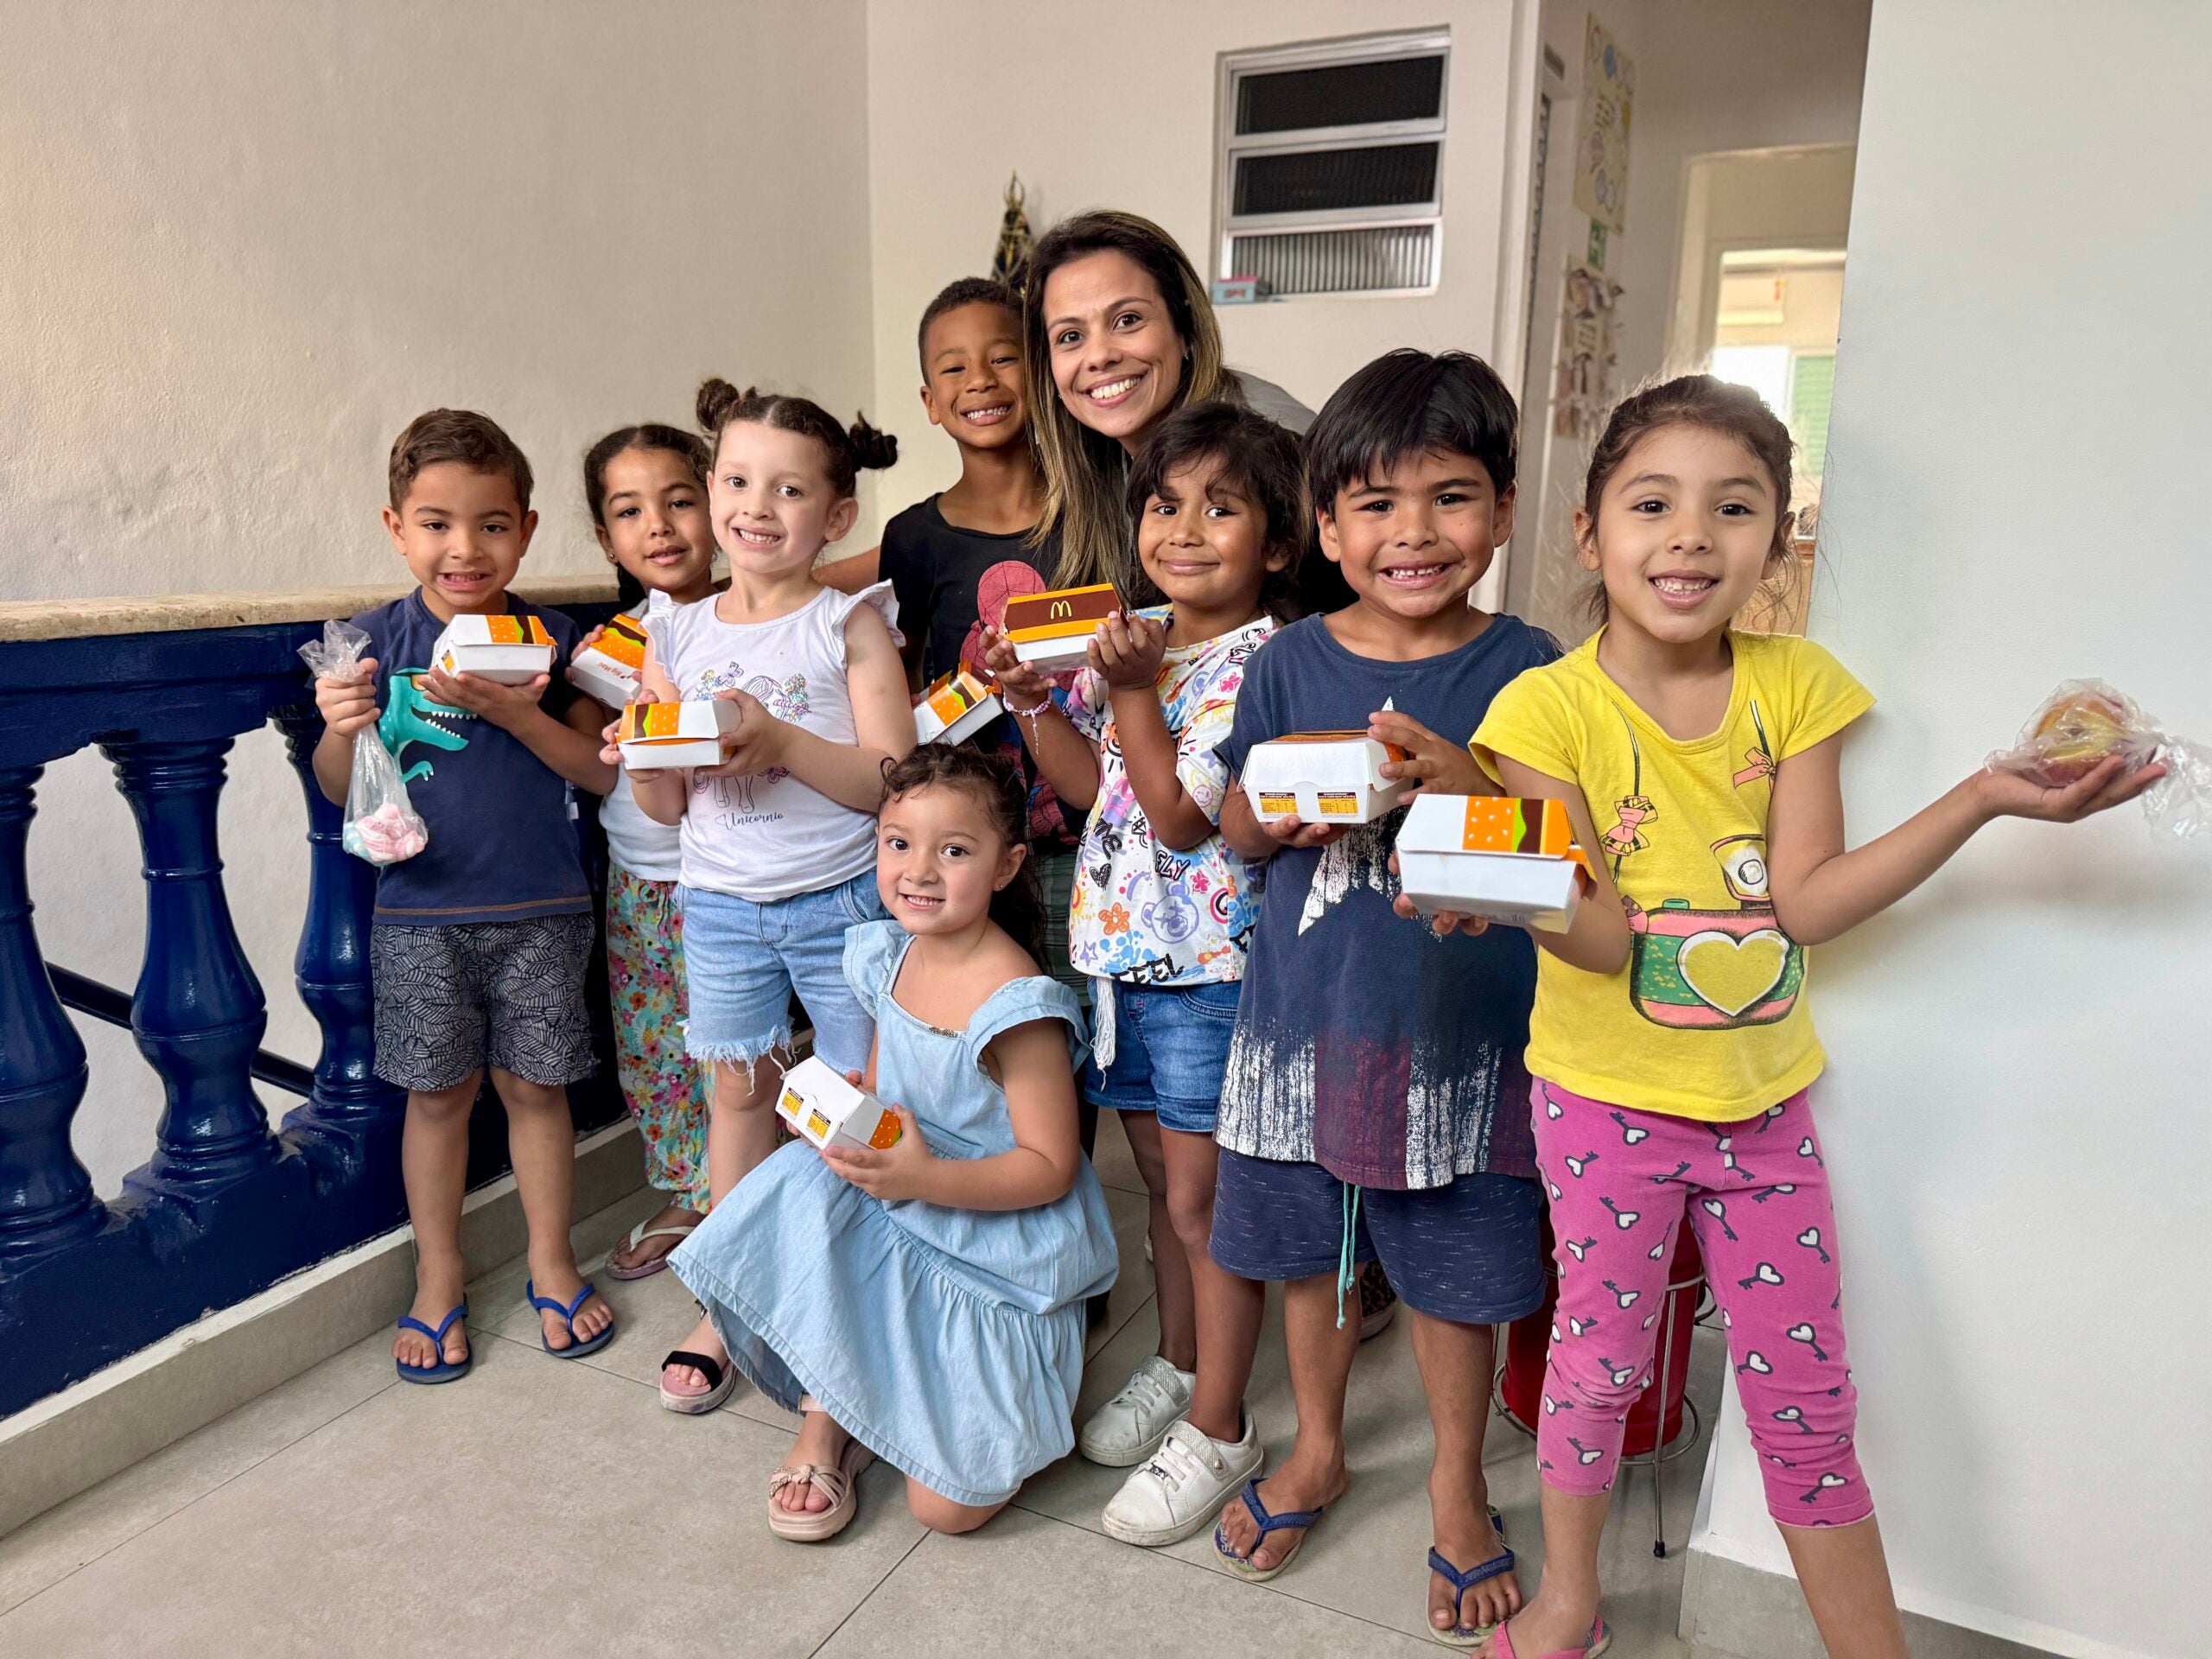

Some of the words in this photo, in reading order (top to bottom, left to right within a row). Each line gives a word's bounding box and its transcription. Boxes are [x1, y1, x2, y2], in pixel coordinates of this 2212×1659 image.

[598, 662, 612, 671] Mac
[612, 668, 623, 677] Big
[715, 812, 783, 830] Unicornio
[1155, 850, 1191, 880] FLY
